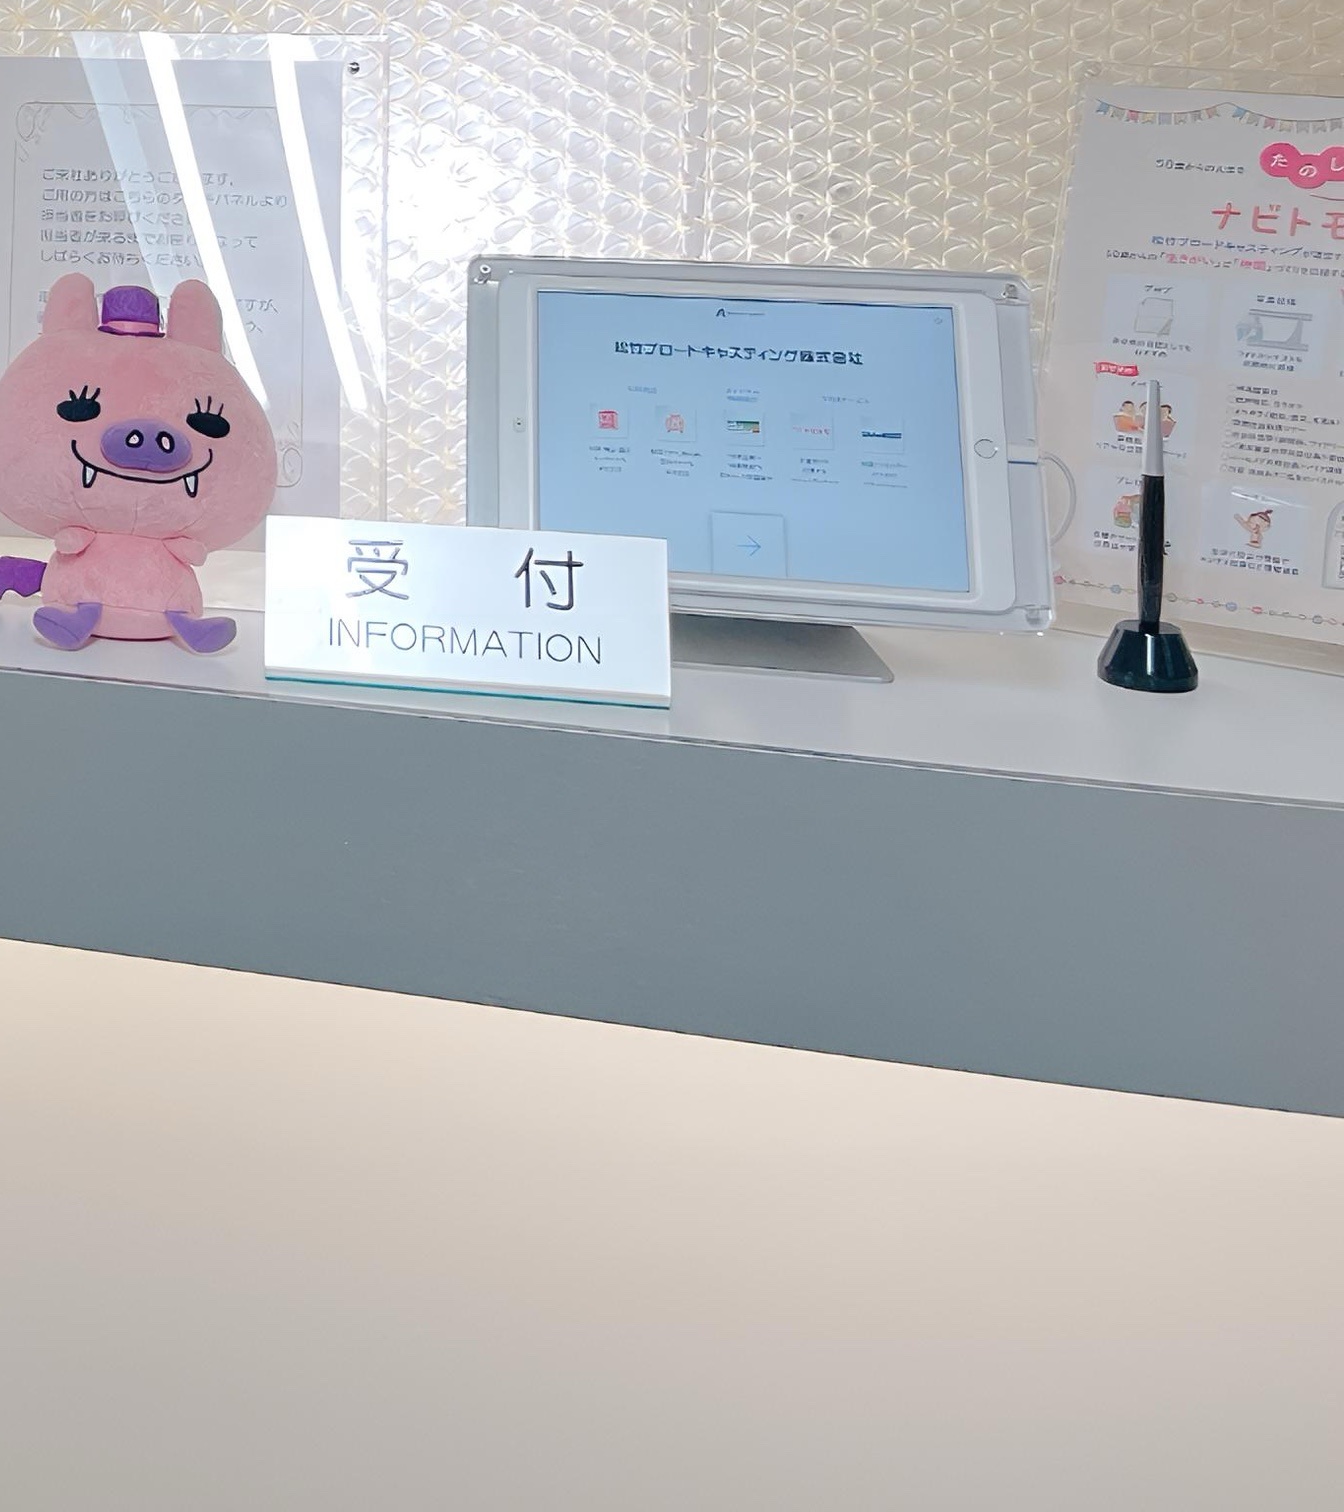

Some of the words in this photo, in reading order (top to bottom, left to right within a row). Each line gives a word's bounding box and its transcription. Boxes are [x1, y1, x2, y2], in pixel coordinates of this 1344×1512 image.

[42, 189, 289, 207] ご用の方はこちらのタパネルより
[345, 539, 584, 611] 受付
[328, 617, 603, 666] INFORMATION
